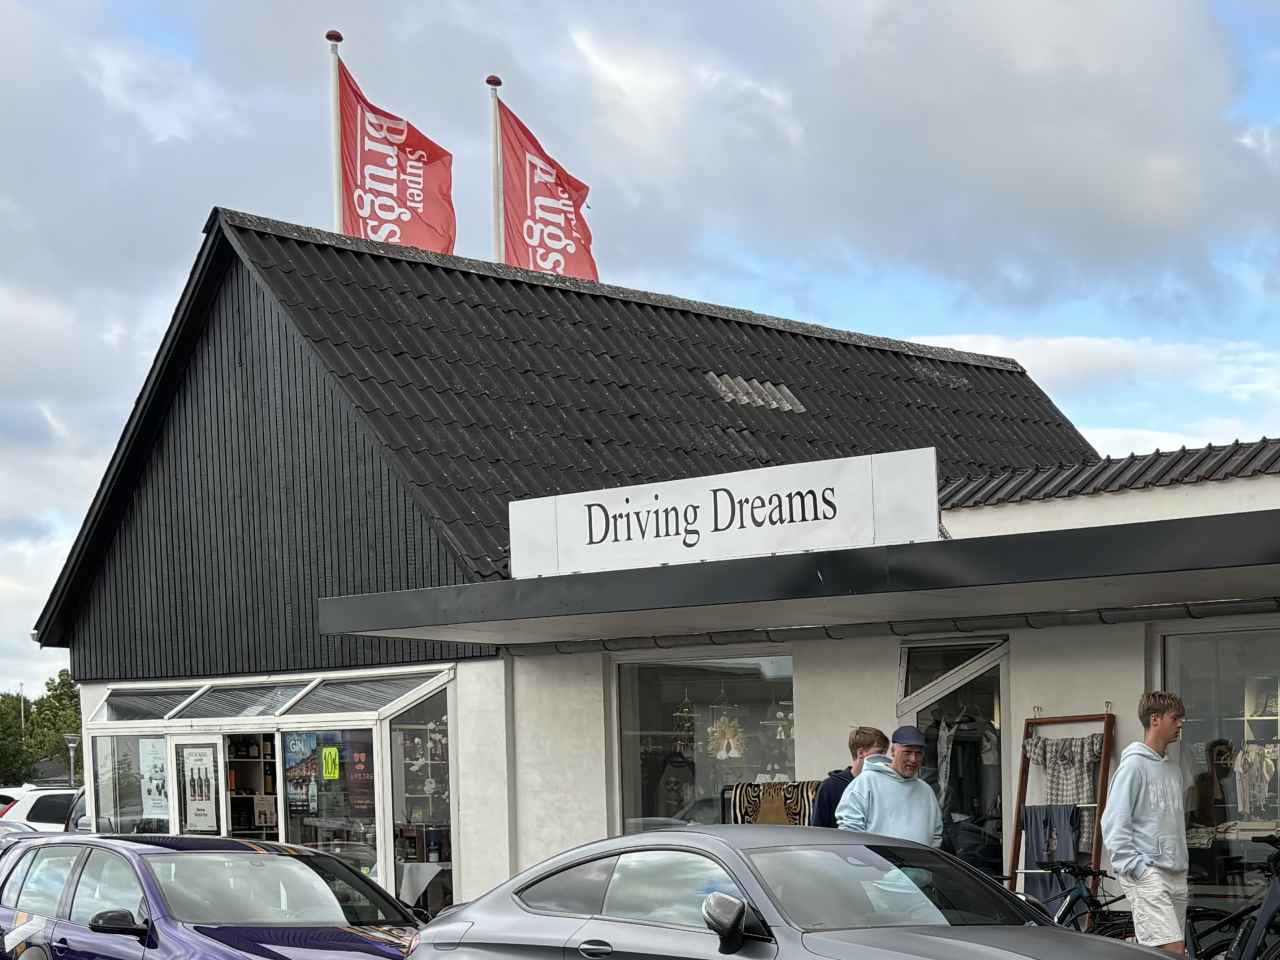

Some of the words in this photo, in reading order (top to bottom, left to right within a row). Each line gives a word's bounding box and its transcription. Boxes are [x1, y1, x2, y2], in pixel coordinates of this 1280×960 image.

[406, 147, 427, 213] Super
[585, 493, 700, 549] Driving
[711, 484, 838, 533] Dreams
